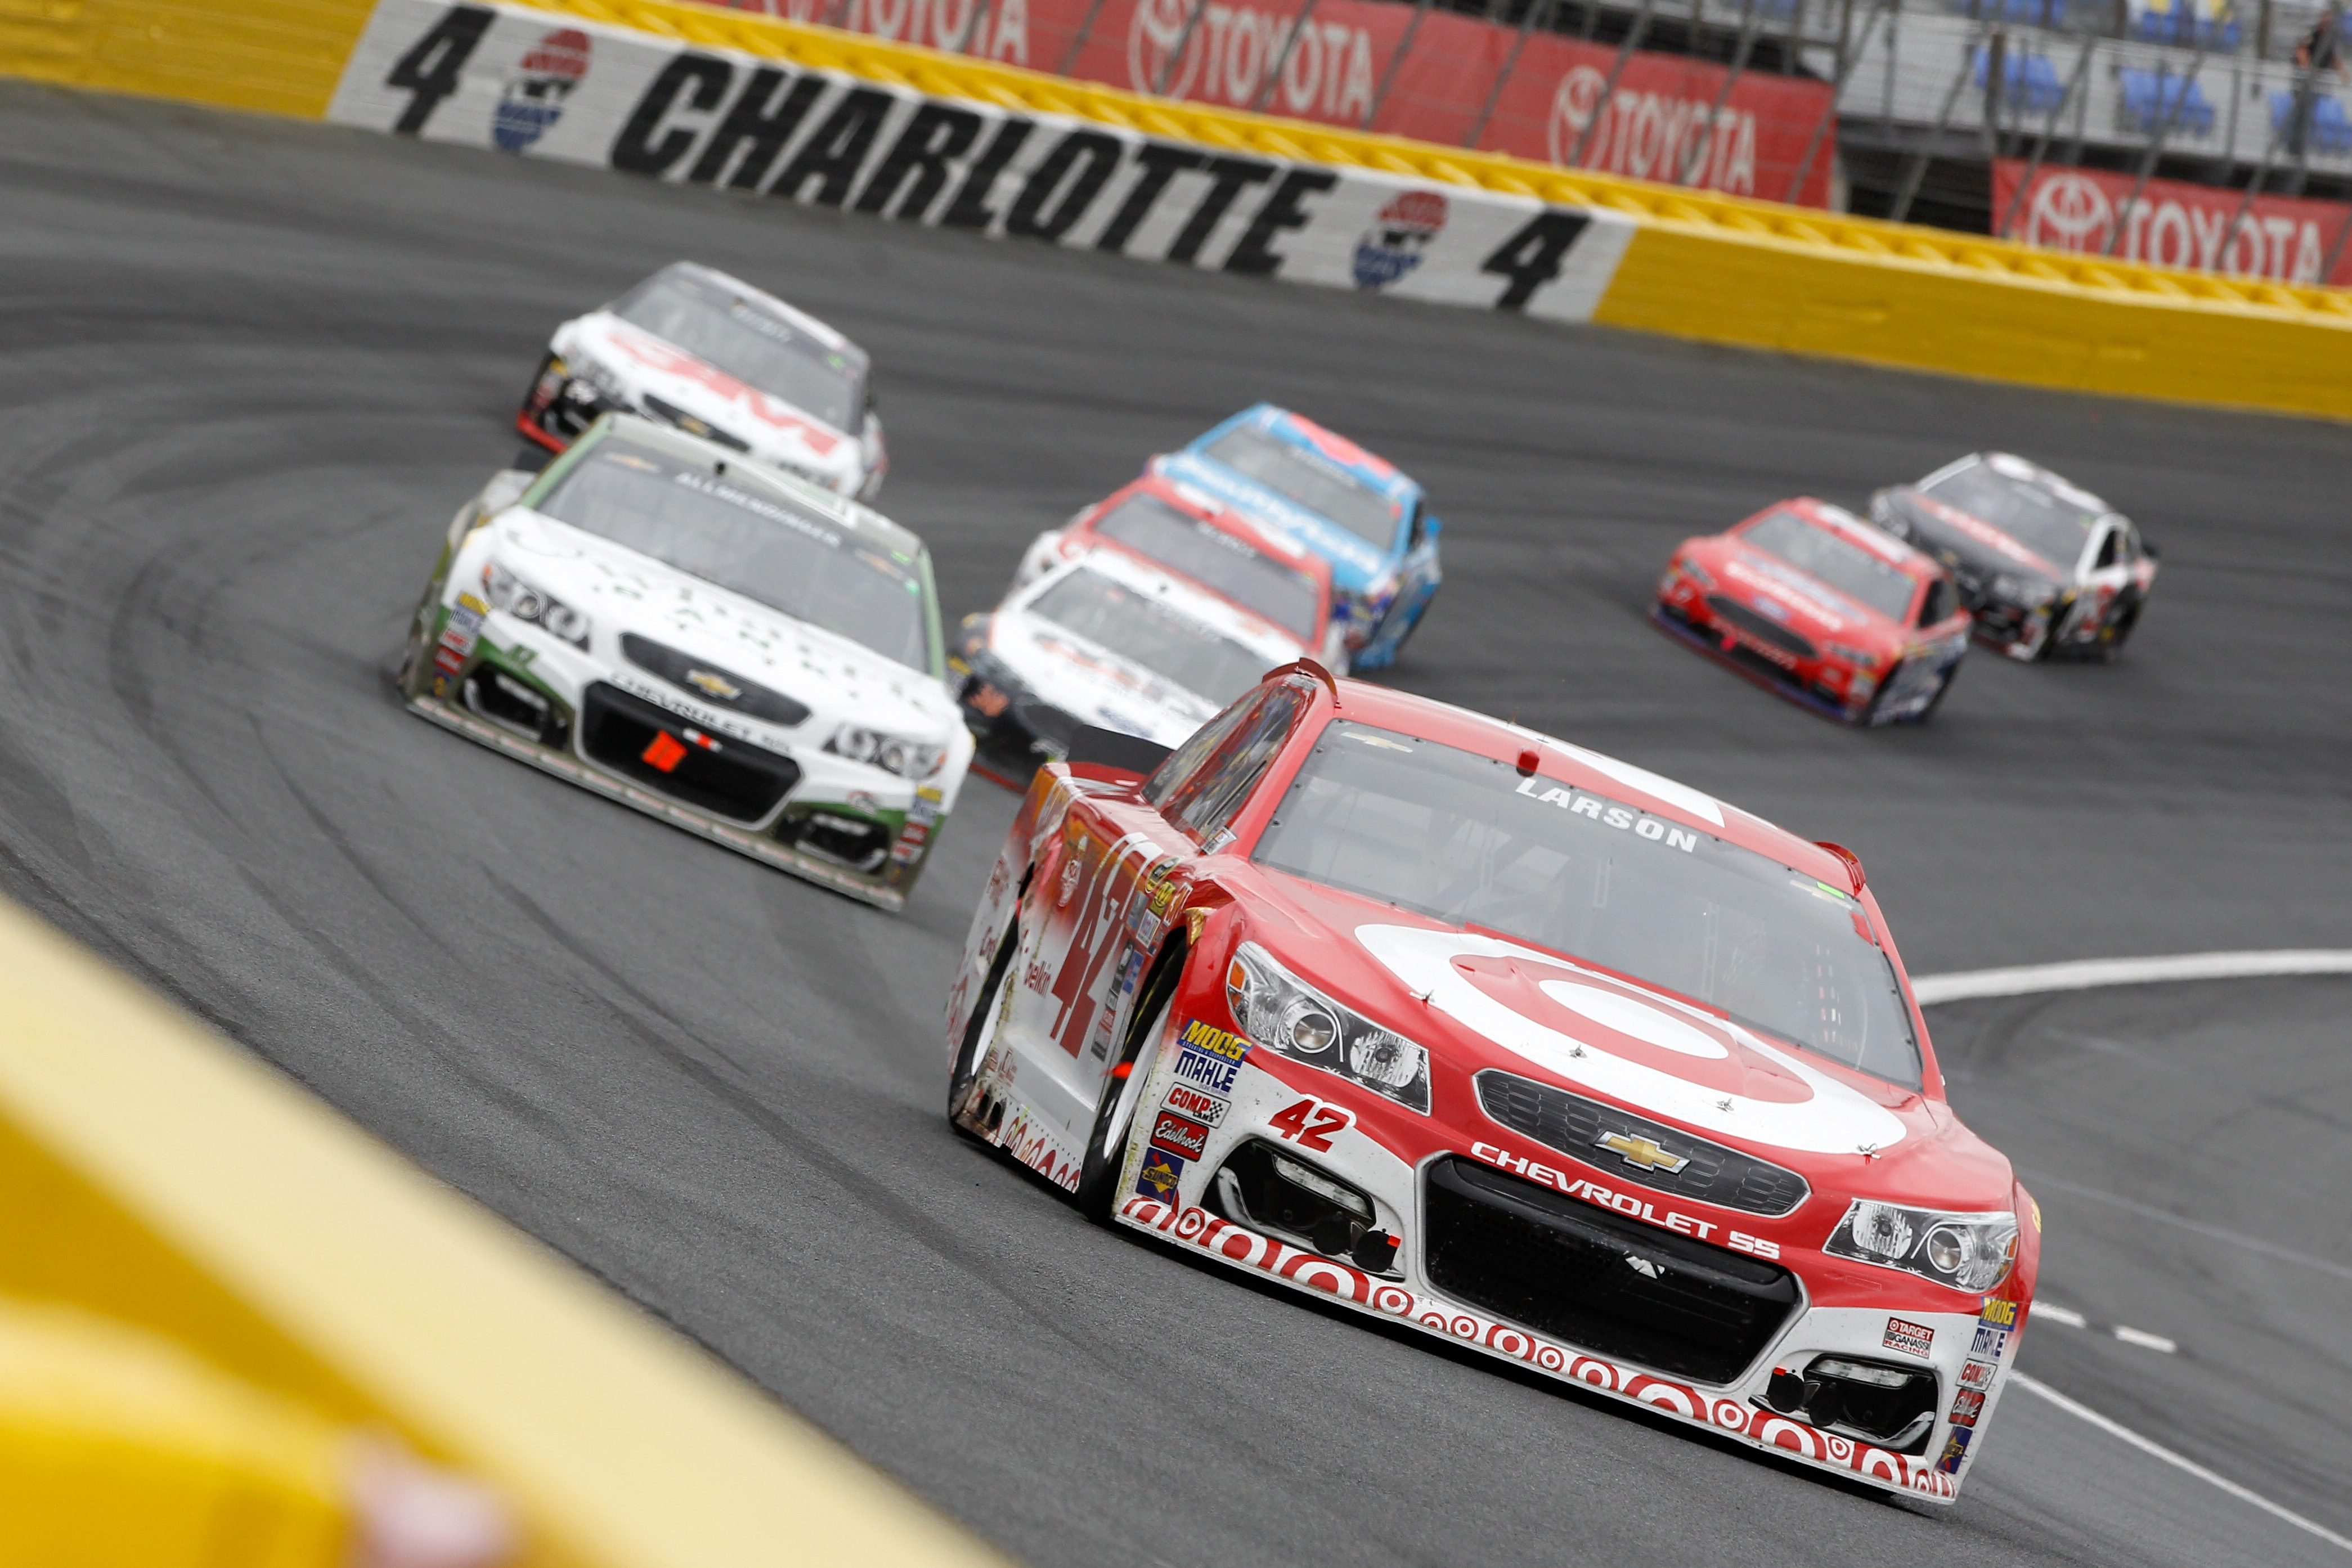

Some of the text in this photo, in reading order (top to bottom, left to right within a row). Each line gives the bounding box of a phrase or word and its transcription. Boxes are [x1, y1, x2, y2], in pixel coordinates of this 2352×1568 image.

[386, 5, 500, 134] 4
[1203, 8, 1374, 119] TOYOTA
[610, 51, 1339, 277] CHARLOTTE
[1612, 89, 1756, 196] TOYOTA
[1480, 205, 1592, 310] 4
[2117, 197, 2323, 286] TOYOTA
[1515, 778, 1698, 853] LARSON
[1051, 832, 1165, 1060] 42
[1174, 1050, 1237, 1093] MAHLE
[1181, 1019, 1253, 1061] MOOG
[1169, 1088, 1211, 1113] COMP
[1192, 1111, 1214, 1123] CAMS
[1268, 1099, 1350, 1153] 42
[1470, 1141, 1780, 1260] CHEVROLET SS
[1884, 1340, 1929, 1356] RACING
[1899, 1322, 1933, 1340] TARGET
[1981, 1297, 2017, 1326] MOOG
